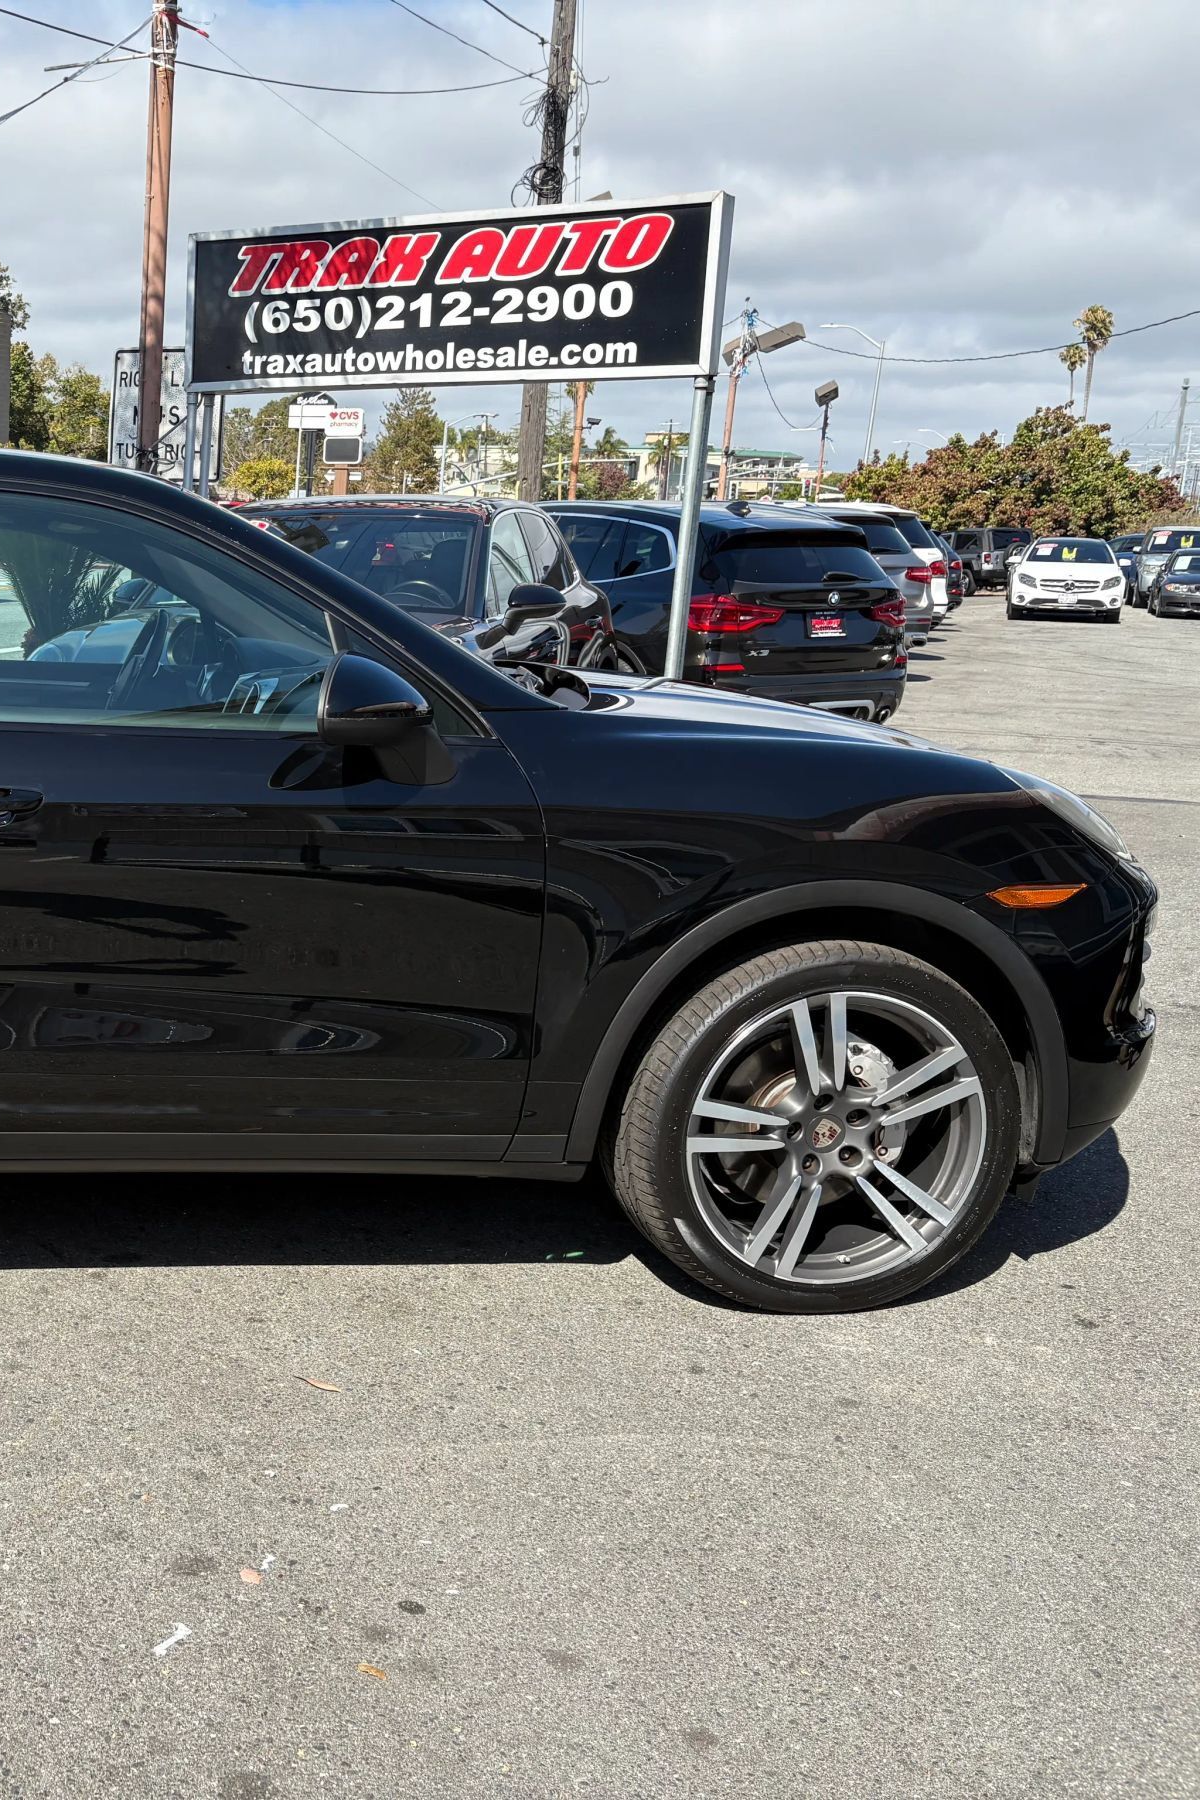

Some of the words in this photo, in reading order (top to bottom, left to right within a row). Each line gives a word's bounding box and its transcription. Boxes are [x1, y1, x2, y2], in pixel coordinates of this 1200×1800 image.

[228, 232, 442, 297] TRAX
[435, 213, 674, 285] AUTO
[244, 280, 634, 344] (650)212-2900
[242, 339, 638, 375] traxautowholesale.com
[339, 411, 359, 420] CVS
[745, 649, 770, 657] X3
